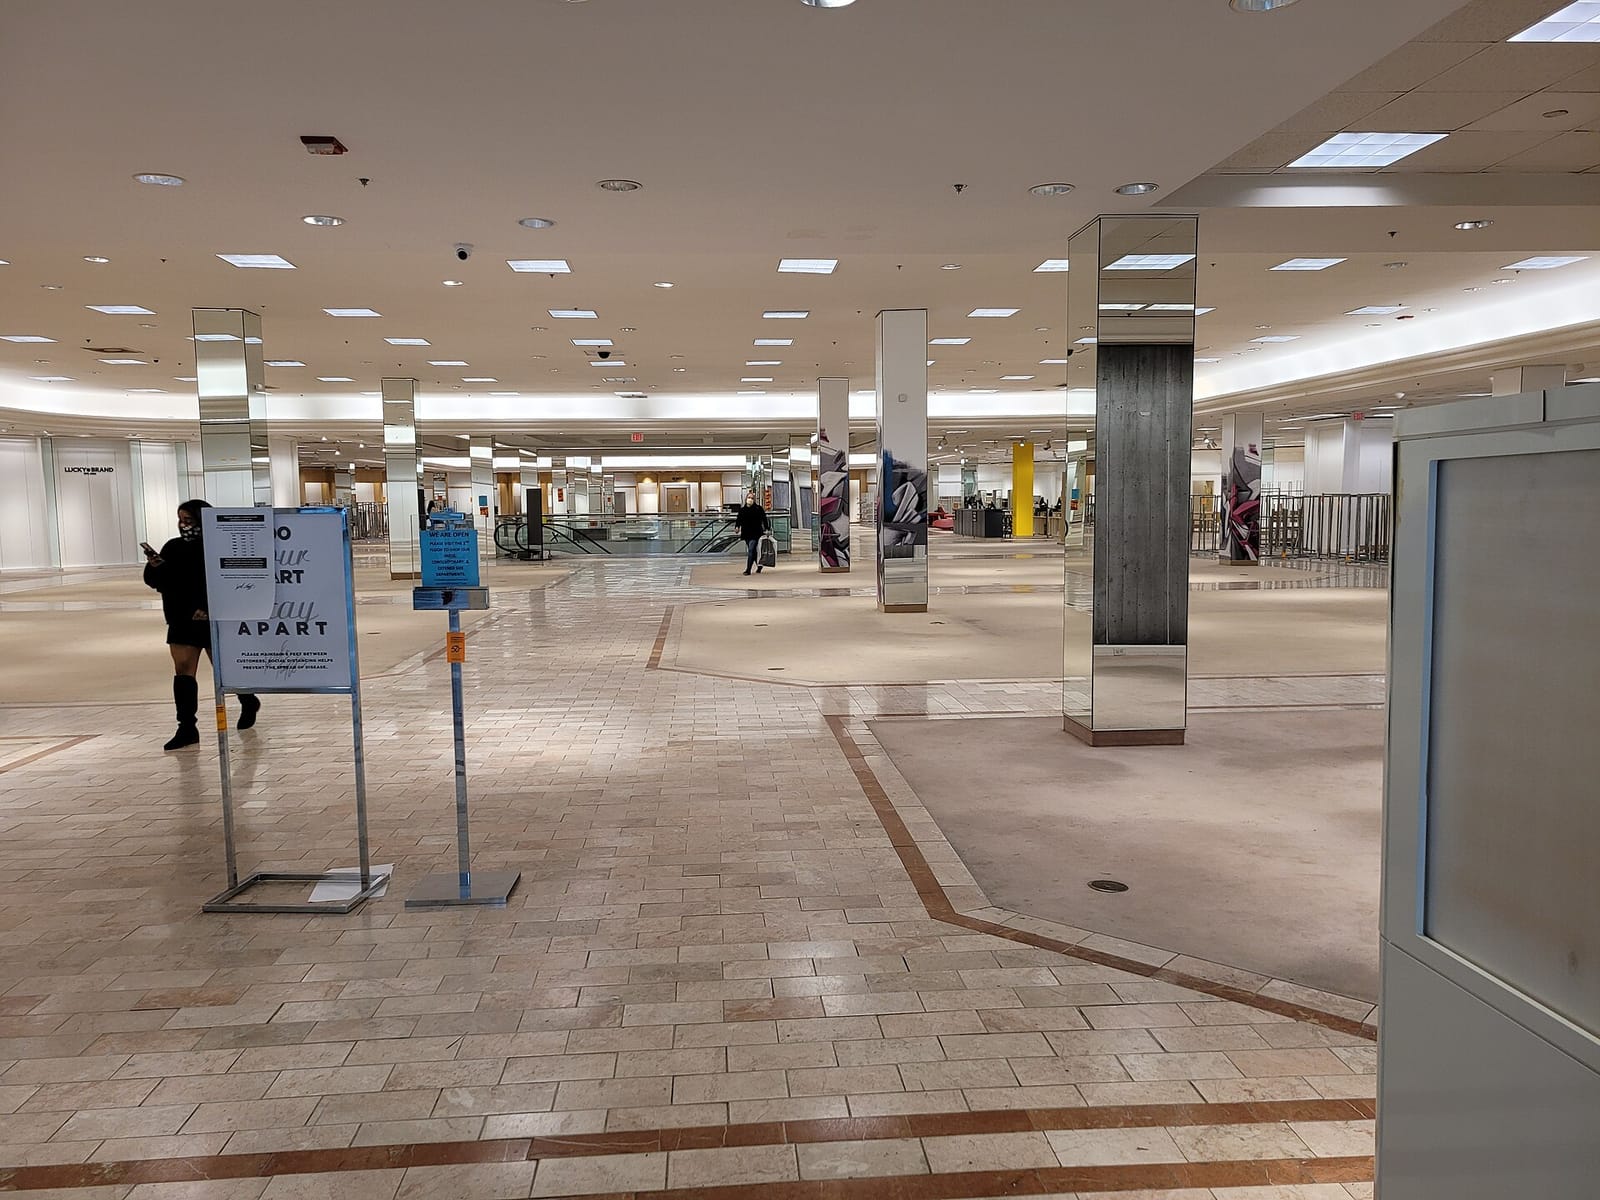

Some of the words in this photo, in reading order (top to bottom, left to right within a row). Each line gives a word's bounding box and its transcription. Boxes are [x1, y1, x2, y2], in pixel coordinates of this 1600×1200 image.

[632, 433, 643, 441] EXIT
[274, 526, 292, 541] O
[274, 550, 310, 567] ur
[238, 622, 328, 635] APART
